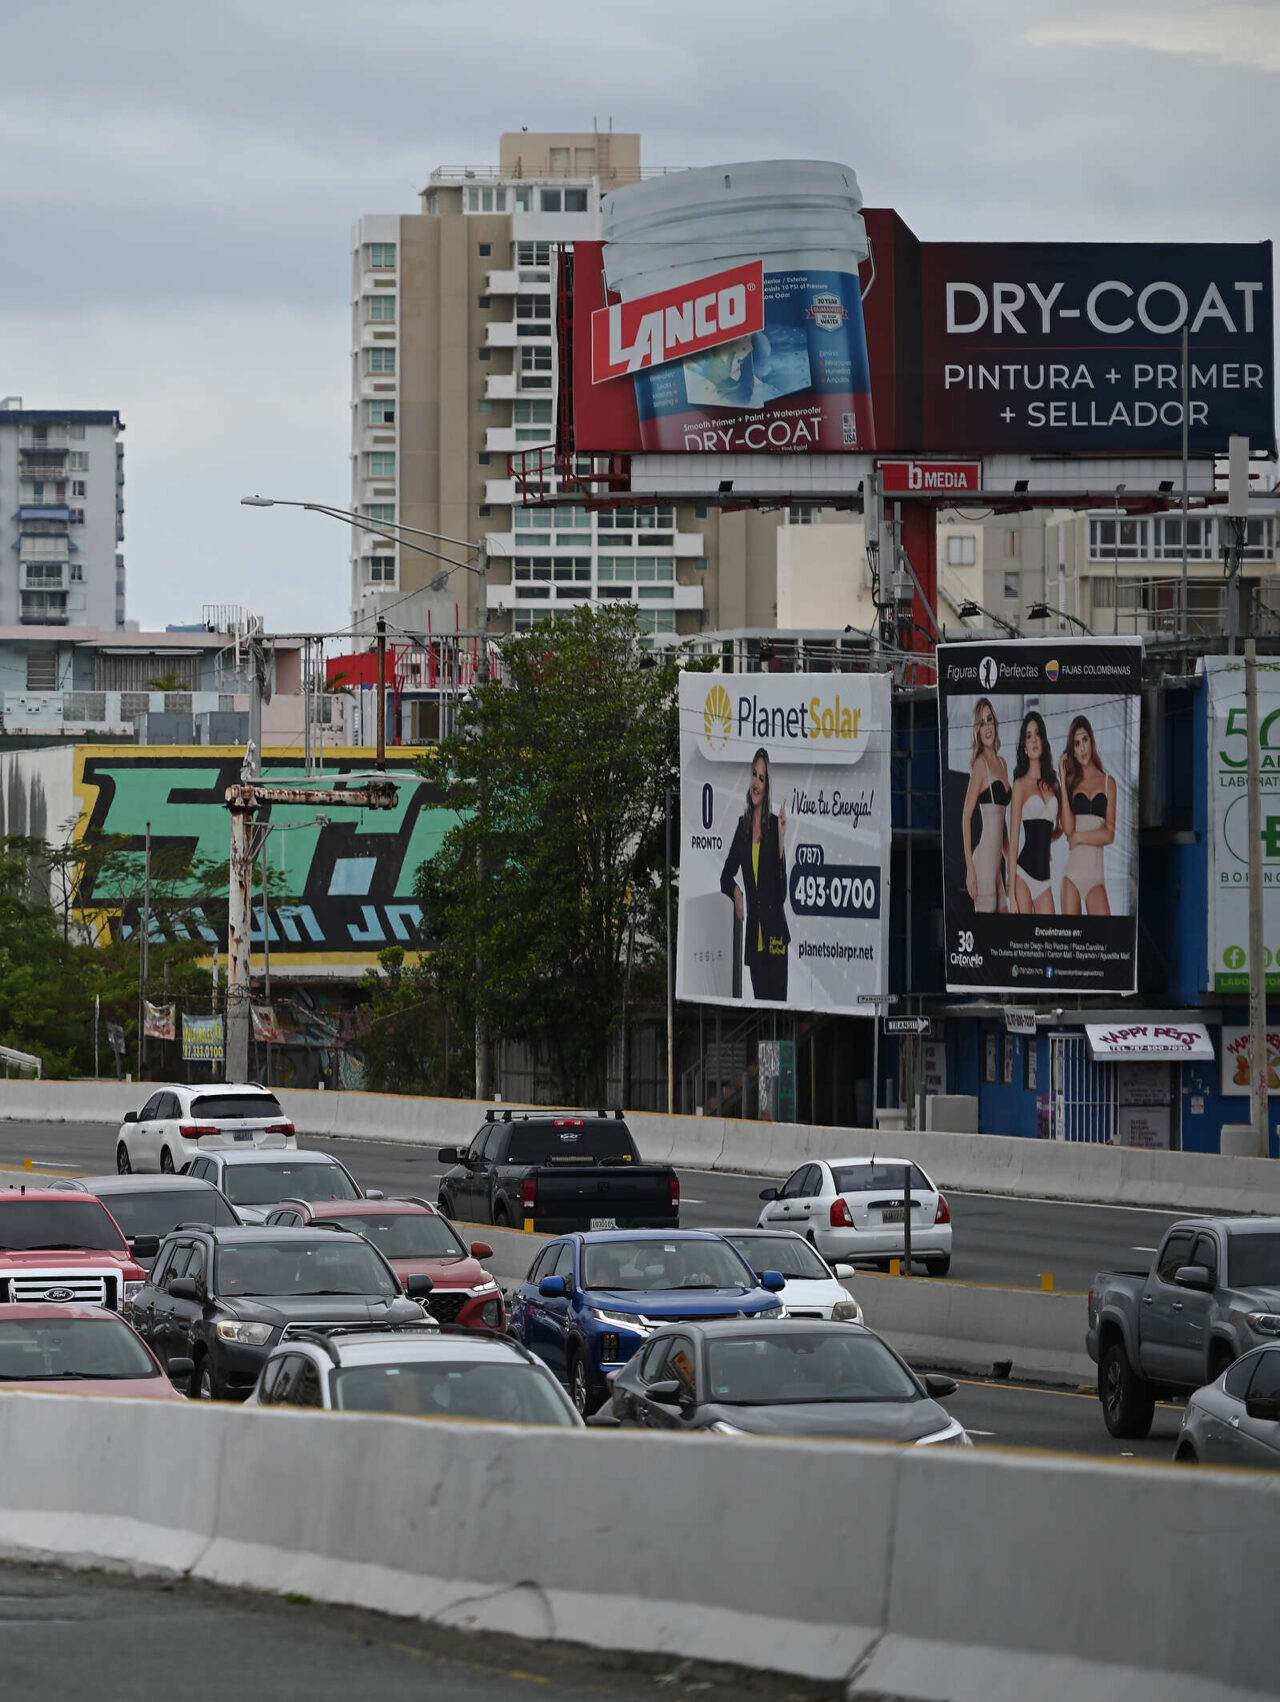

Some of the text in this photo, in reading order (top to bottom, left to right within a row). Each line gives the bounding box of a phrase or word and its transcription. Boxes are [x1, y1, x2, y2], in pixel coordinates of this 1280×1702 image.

[946, 280, 1263, 334] DRY-COAT
[609, 283, 747, 373] LANCO
[944, 364, 1095, 390] PINTURA
[683, 422, 710, 432] Smooth
[712, 417, 736, 428] Primer
[745, 413, 764, 423] Paint
[773, 406, 821, 418] Waterproofer
[1027, 401, 1209, 427] SELLADOR
[684, 417, 822, 450] DRY-COAT
[925, 471, 968, 488] MEDIA
[947, 663, 1039, 682] Figuras Perfectas
[1062, 665, 1131, 676] FAJAS COLOMBIANAS
[702, 782, 714, 830] 0
[819, 789, 830, 815] tu
[832, 789, 875, 829] Energía!
[691, 835, 723, 850] PRONTO
[798, 847, 821, 865] (787)
[1034, 927, 1082, 937] Encuéntranos en:
[798, 940, 874, 961] planetsolarpr.net
[1085, 943, 1104, 951] Carolina
[1099, 1026, 1202, 1046] HAPPY PETS
